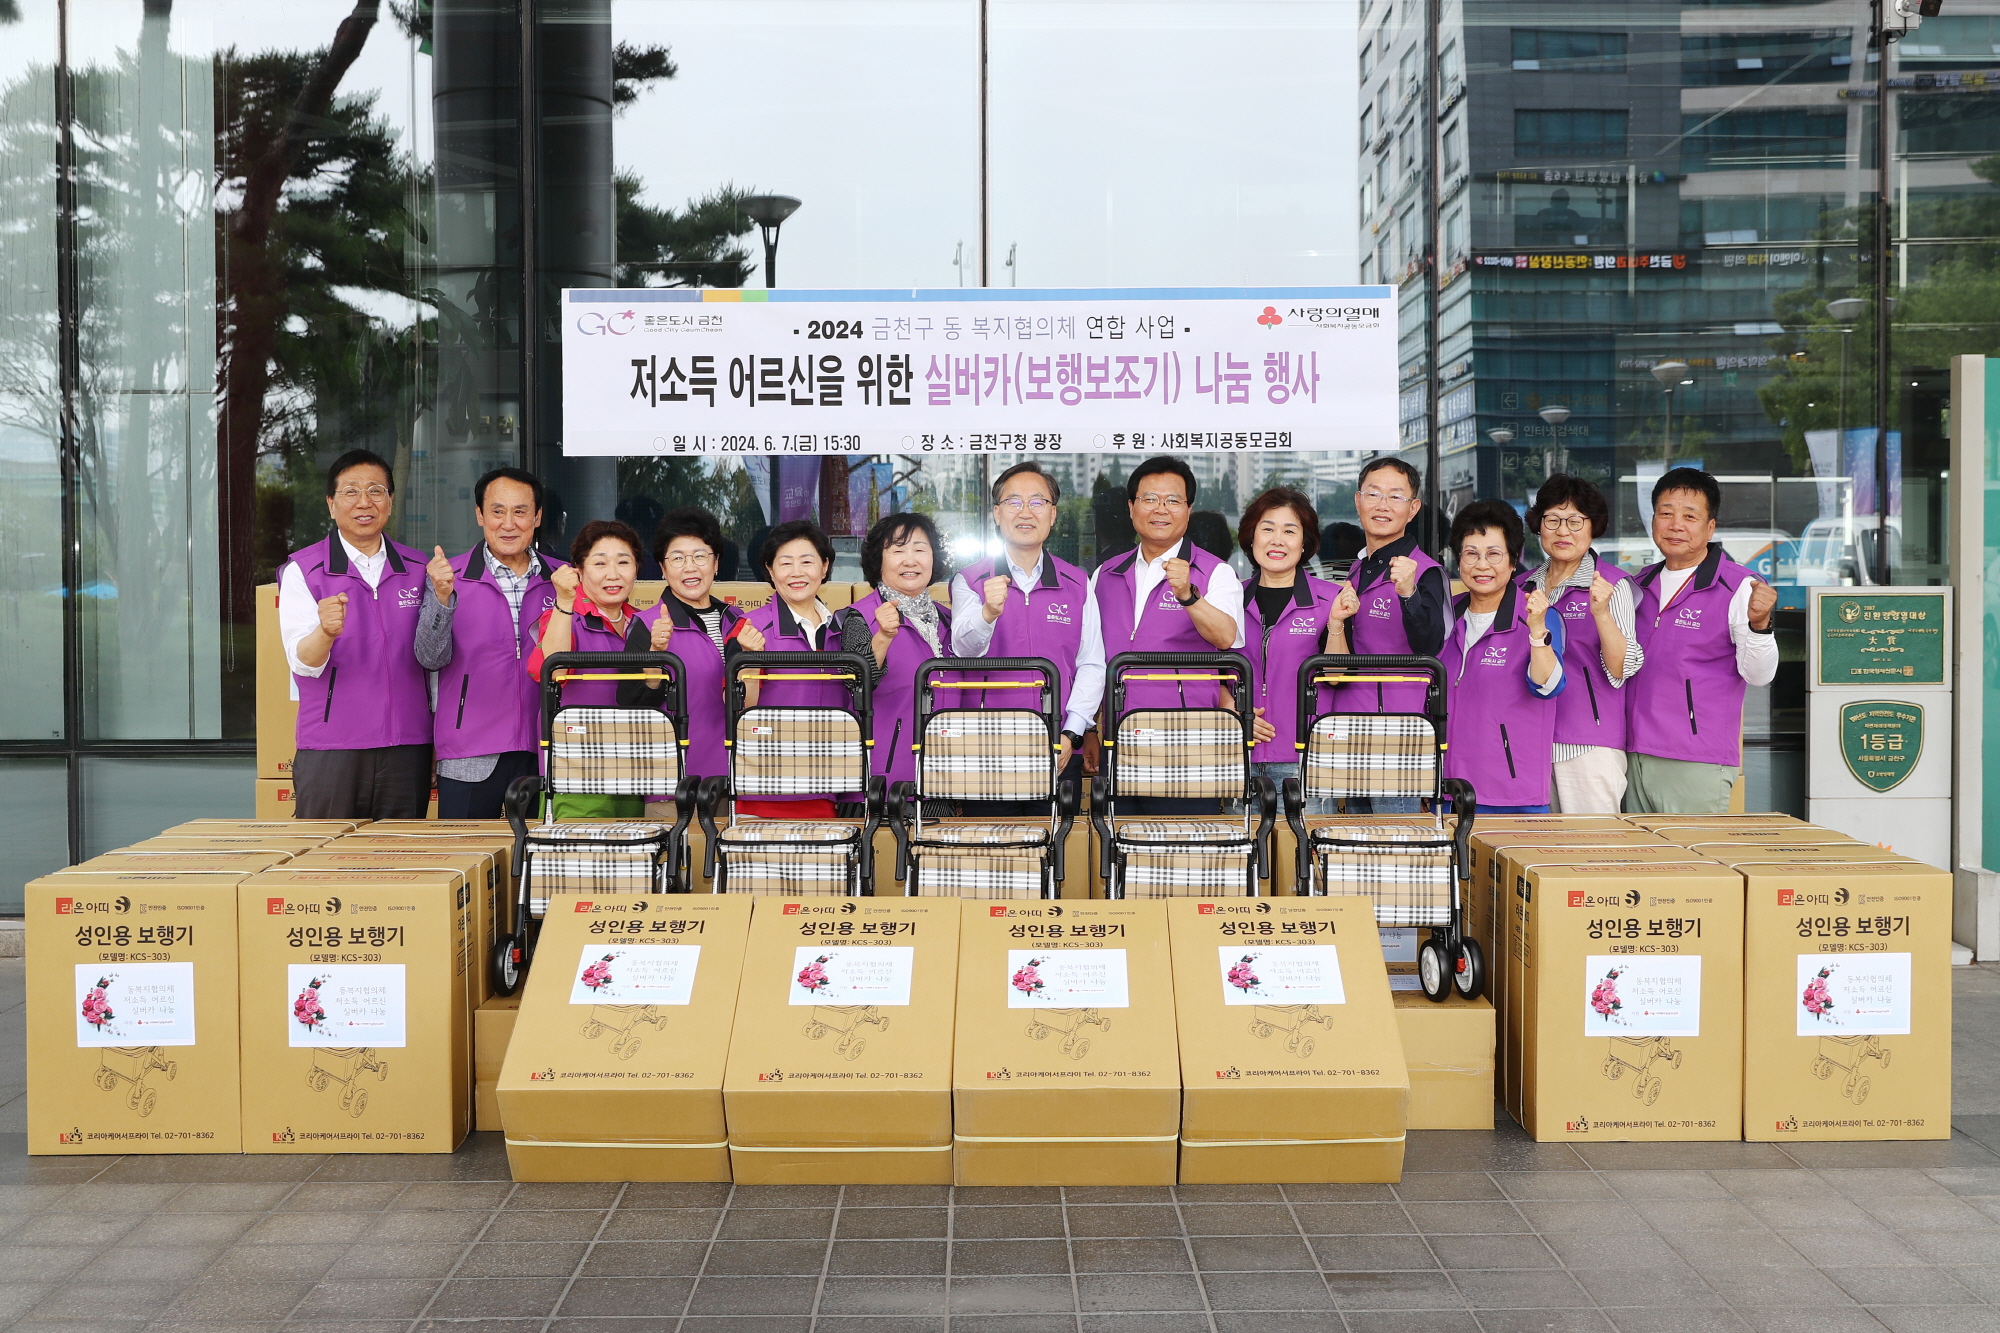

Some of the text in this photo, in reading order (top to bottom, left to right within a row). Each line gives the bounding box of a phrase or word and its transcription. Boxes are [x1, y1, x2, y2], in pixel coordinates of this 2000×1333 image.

[644, 316, 722, 325] 좋은도시 금천
[1288, 308, 1379, 322] 사랑의열매
[577, 312, 636, 336] GC
[808, 316, 1173, 340] 2024 금천구 동 복지협의체 연합 사업
[630, 351, 1320, 407] 저소득 어르신을 위한 실버카(보행보조기) 나눔 행사
[1523, 425, 1589, 437] 인터넷검색대
[673, 436, 685, 452] 일
[721, 436, 758, 451] 2024.
[765, 436, 775, 451] 6.
[782, 435, 816, 452] 7.(금)
[824, 435, 860, 450] 15:30
[921, 435, 934, 451] 장
[970, 434, 1026, 450] 금천구청
[1034, 434, 1062, 450] 광장
[1113, 434, 1125, 449] 후
[1161, 432, 1291, 449] 사회복지공동모금회
[398, 587, 420, 599] GC
[1048, 602, 1068, 615] GC
[1373, 598, 1392, 610] GC
[1566, 601, 1588, 612] GC
[1680, 608, 1701, 619] GC
[1292, 618, 1314, 628] GC
[1484, 646, 1507, 658] GC
[1860, 734, 1904, 751] 1등급
[1568, 890, 1620, 908] 라온아띠
[1778, 889, 1829, 906] 라온아띠
[56, 897, 109, 914] 라온아띠
[267, 897, 320, 915] 라온아띠
[574, 901, 627, 913] 라온아띠
[782, 903, 835, 915] 라온아띠
[1198, 903, 1251, 915] 라온아띠
[990, 906, 1042, 918] 라온아띠
[589, 920, 705, 933] 성인용 보행기
[800, 922, 915, 935] 성인용 보행기
[1009, 924, 1124, 938] 성인용 보행기
[1219, 921, 1335, 935] 성인용 보행기
[1587, 918, 1700, 939] 성인용 보행기
[1796, 916, 1909, 937] 성인용 보행기
[75, 926, 192, 946] 성인용 보행기
[287, 926, 403, 947] 성인용 보행기
[608, 937, 679, 945] (모델명: KCS-303)
[1609, 944, 1679, 954] (모델명: KCS-303)
[1818, 942, 1888, 953] (모델명: KCS-303)
[98, 952, 171, 962] (모델명: KCS-303)
[309, 953, 381, 963] (모델명: KCS-303)
[1632, 986, 1682, 996] 저소득 어르신
[1843, 984, 1893, 995] 저소득 어르신
[123, 995, 175, 1005] 저소득 어르신
[335, 996, 387, 1006] 저소득 어르신
[1639, 996, 1682, 1007] 실버카 나눔
[1850, 995, 1893, 1005] 실버카 나눔
[131, 1005, 175, 1015] 실버카 나눔
[343, 1006, 386, 1016] 실버카 나눔
